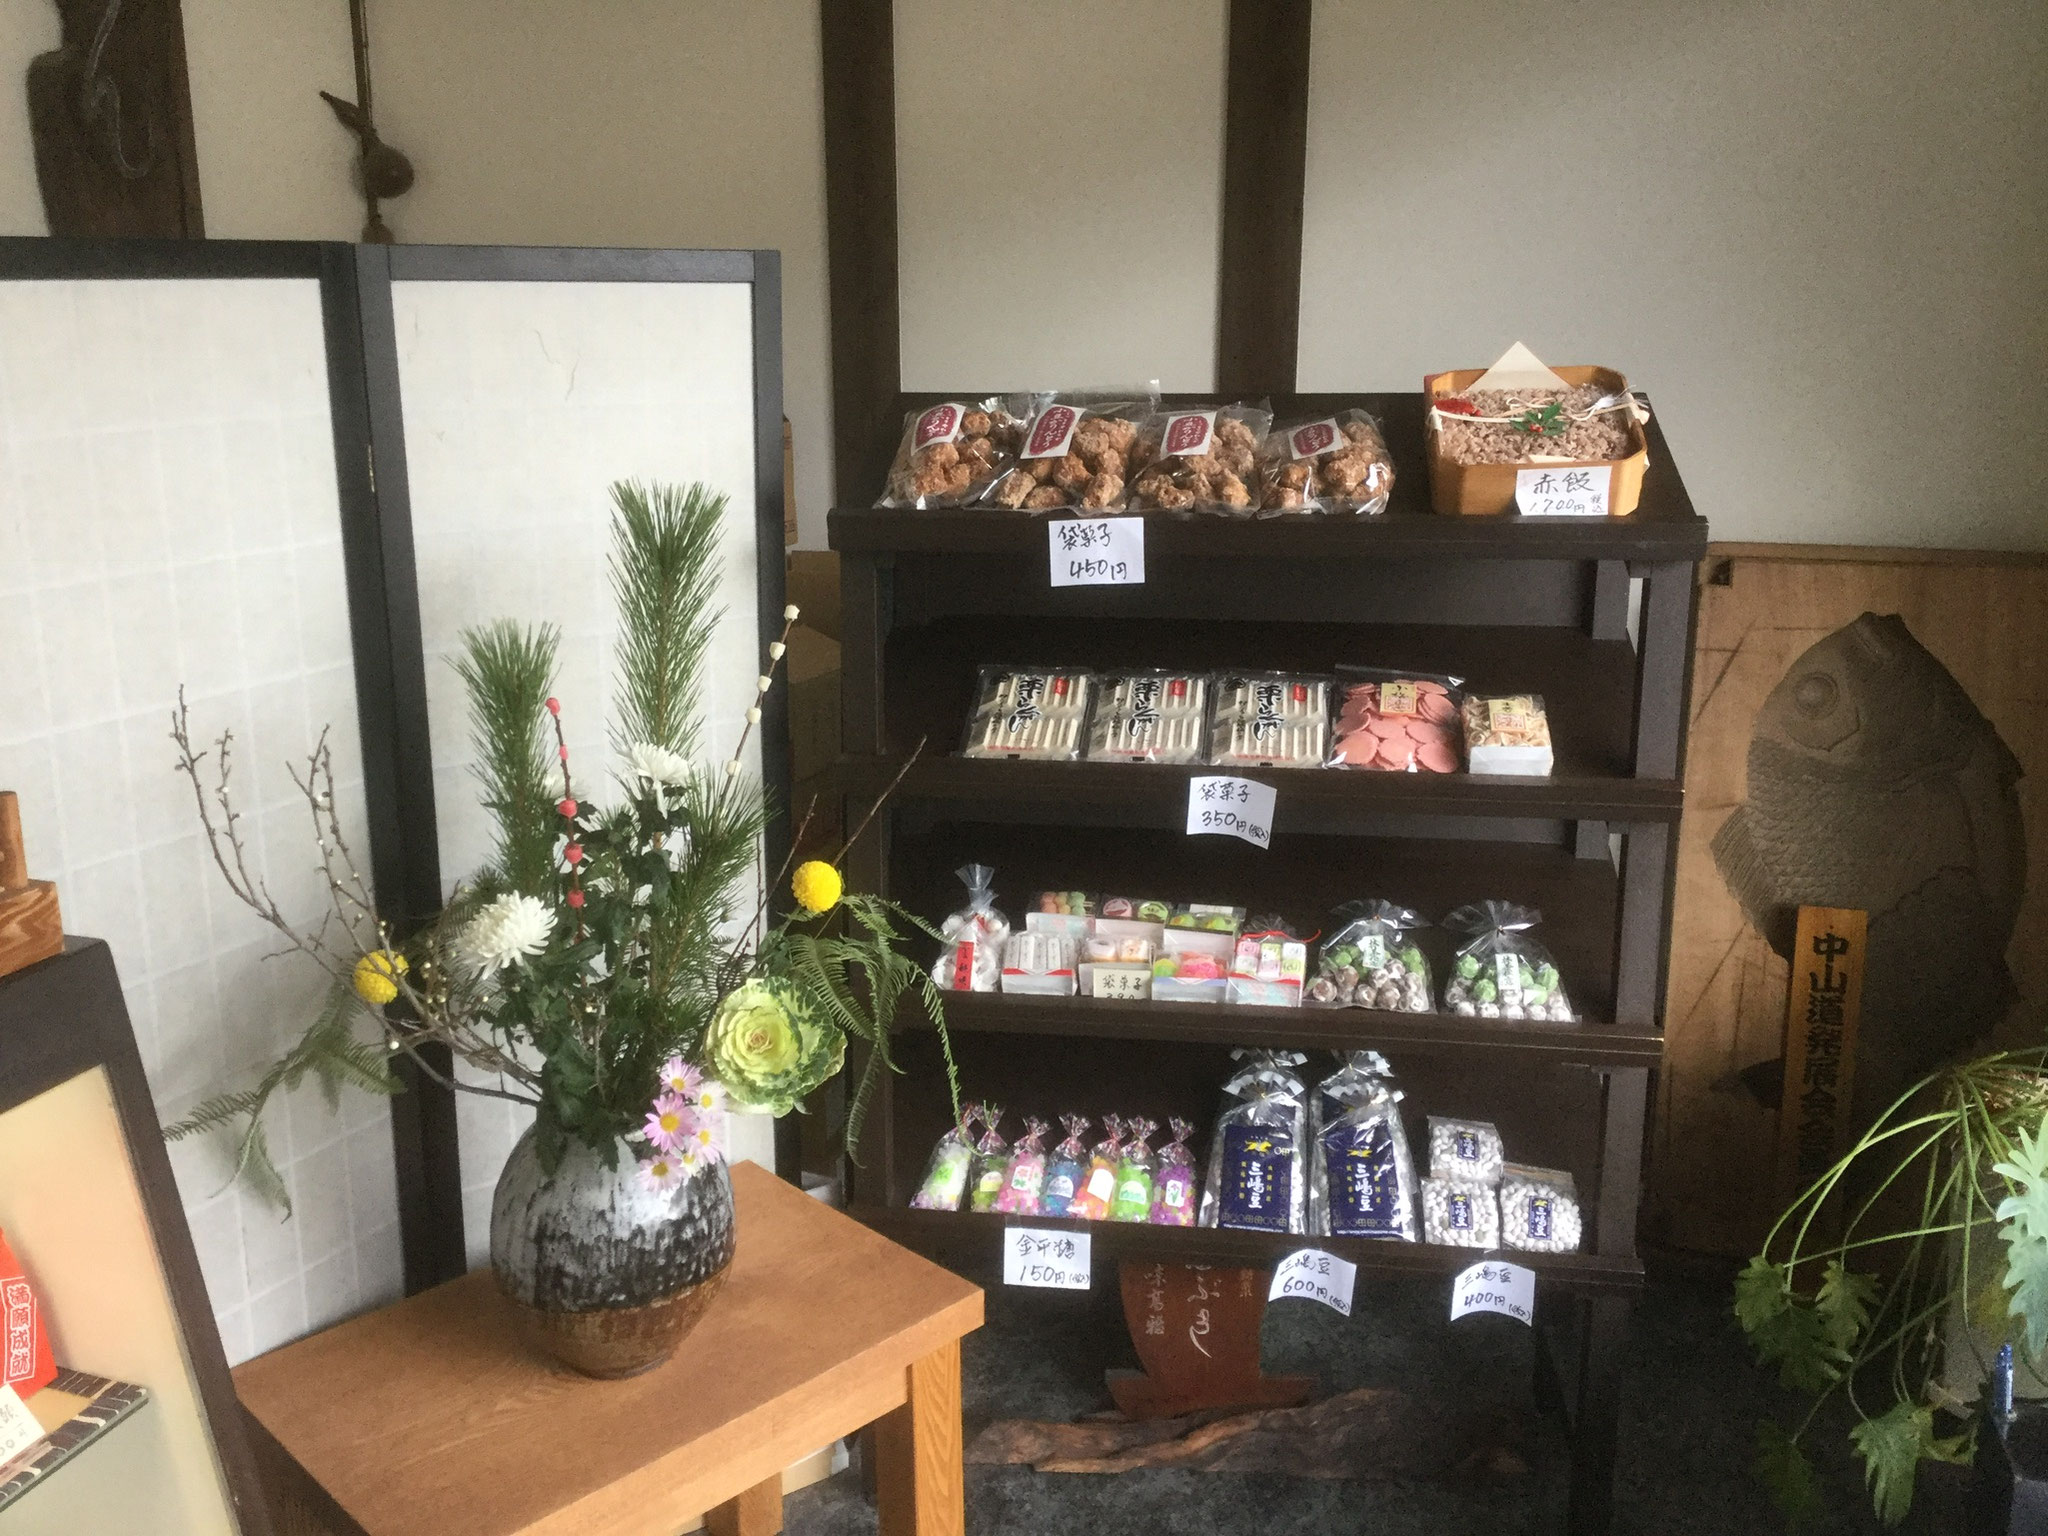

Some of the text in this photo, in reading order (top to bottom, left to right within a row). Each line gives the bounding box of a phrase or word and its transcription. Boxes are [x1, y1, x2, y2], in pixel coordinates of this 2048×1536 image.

[1533, 472, 1595, 494] 赤飯
[1058, 523, 1112, 550] 袋菓子
[1070, 558, 1127, 580] 450円
[1199, 780, 1251, 803] 袋菓子
[1016, 1234, 1075, 1260] 金平糖
[1019, 1265, 1066, 1284] 150円
[8, 1284, 31, 1377] 満願成就
